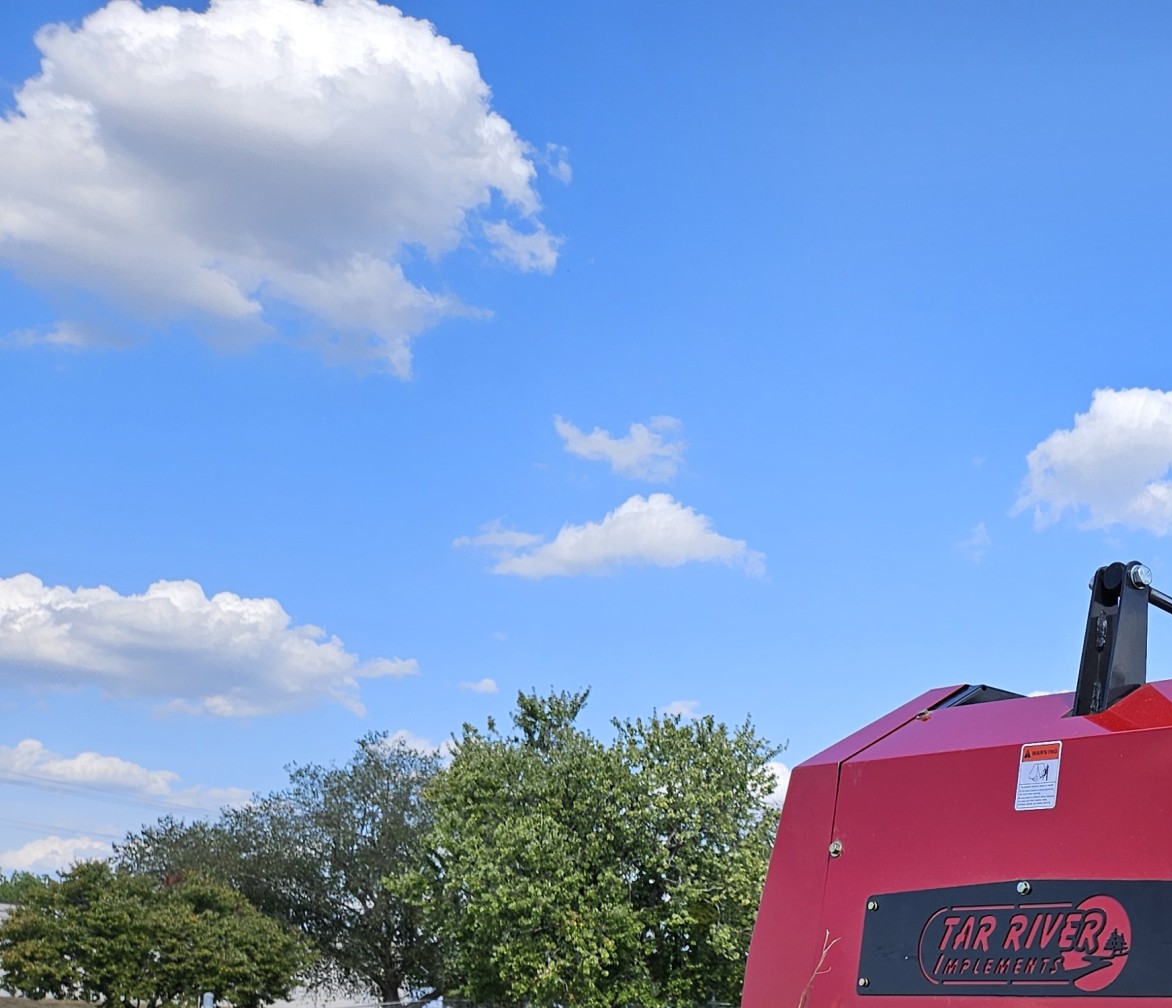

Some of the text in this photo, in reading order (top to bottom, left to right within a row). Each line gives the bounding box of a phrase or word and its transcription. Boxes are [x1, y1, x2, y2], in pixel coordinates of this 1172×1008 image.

[938, 912, 1105, 952] TAR RIVER
[933, 953, 1062, 975] IMPLEMENTS
